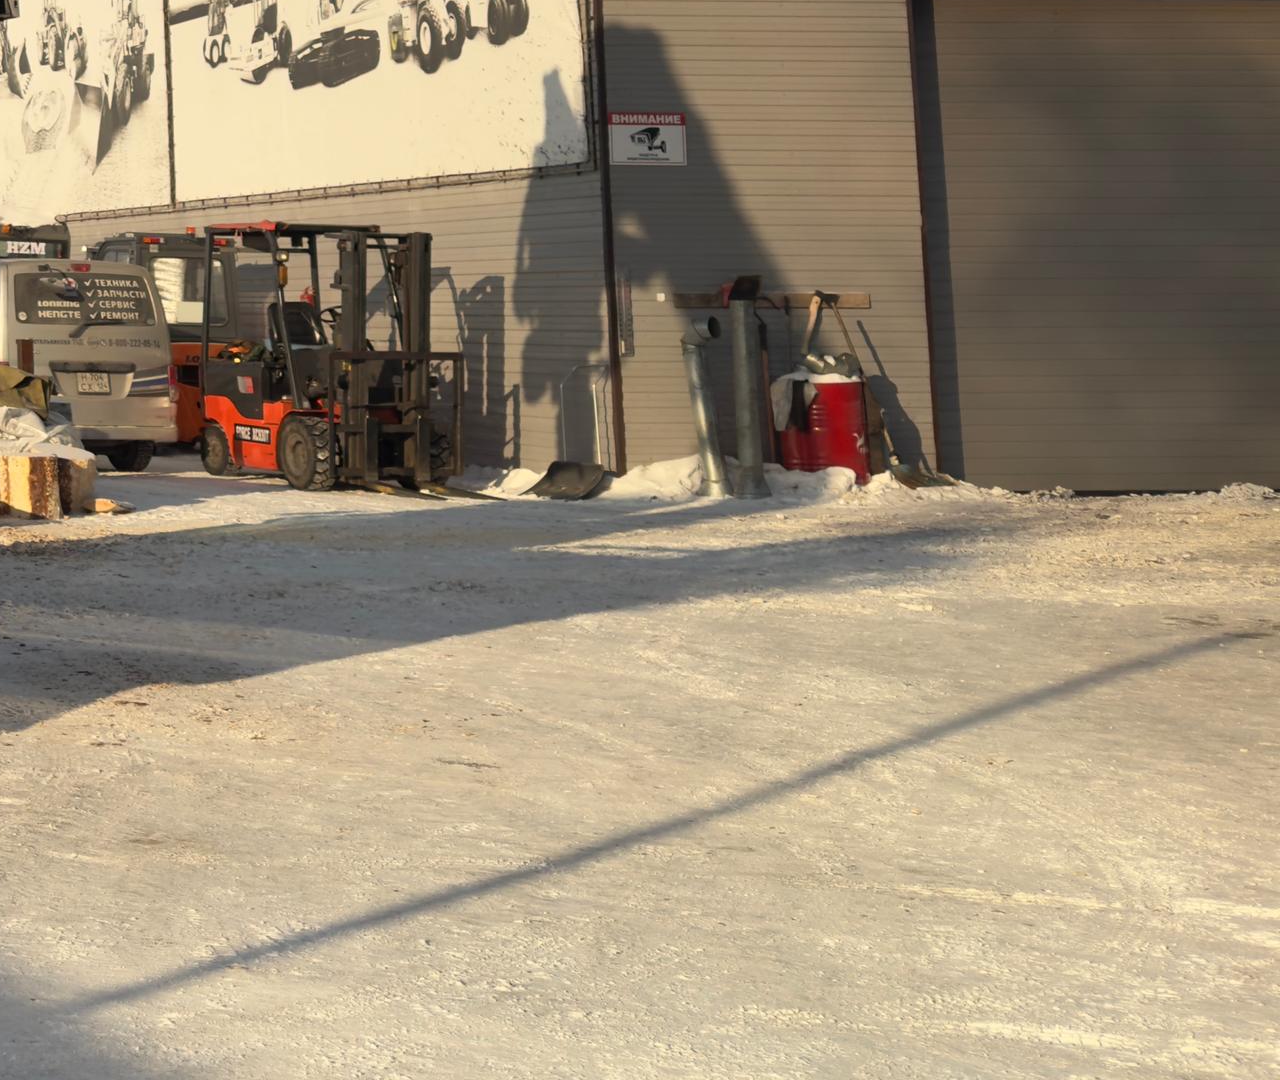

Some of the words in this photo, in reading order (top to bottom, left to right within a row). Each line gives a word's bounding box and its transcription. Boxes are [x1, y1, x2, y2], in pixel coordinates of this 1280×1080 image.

[612, 114, 681, 124] ВНИМАНИЕ
[6, 241, 46, 255] HZM
[95, 279, 139, 288] ТЕХНИКА
[97, 290, 146, 299] ЗАПЧАСТИ
[99, 301, 136, 309] СЕРВИС
[38, 310, 81, 318] HENGTE
[101, 311, 139, 320] РЕМОНТ
